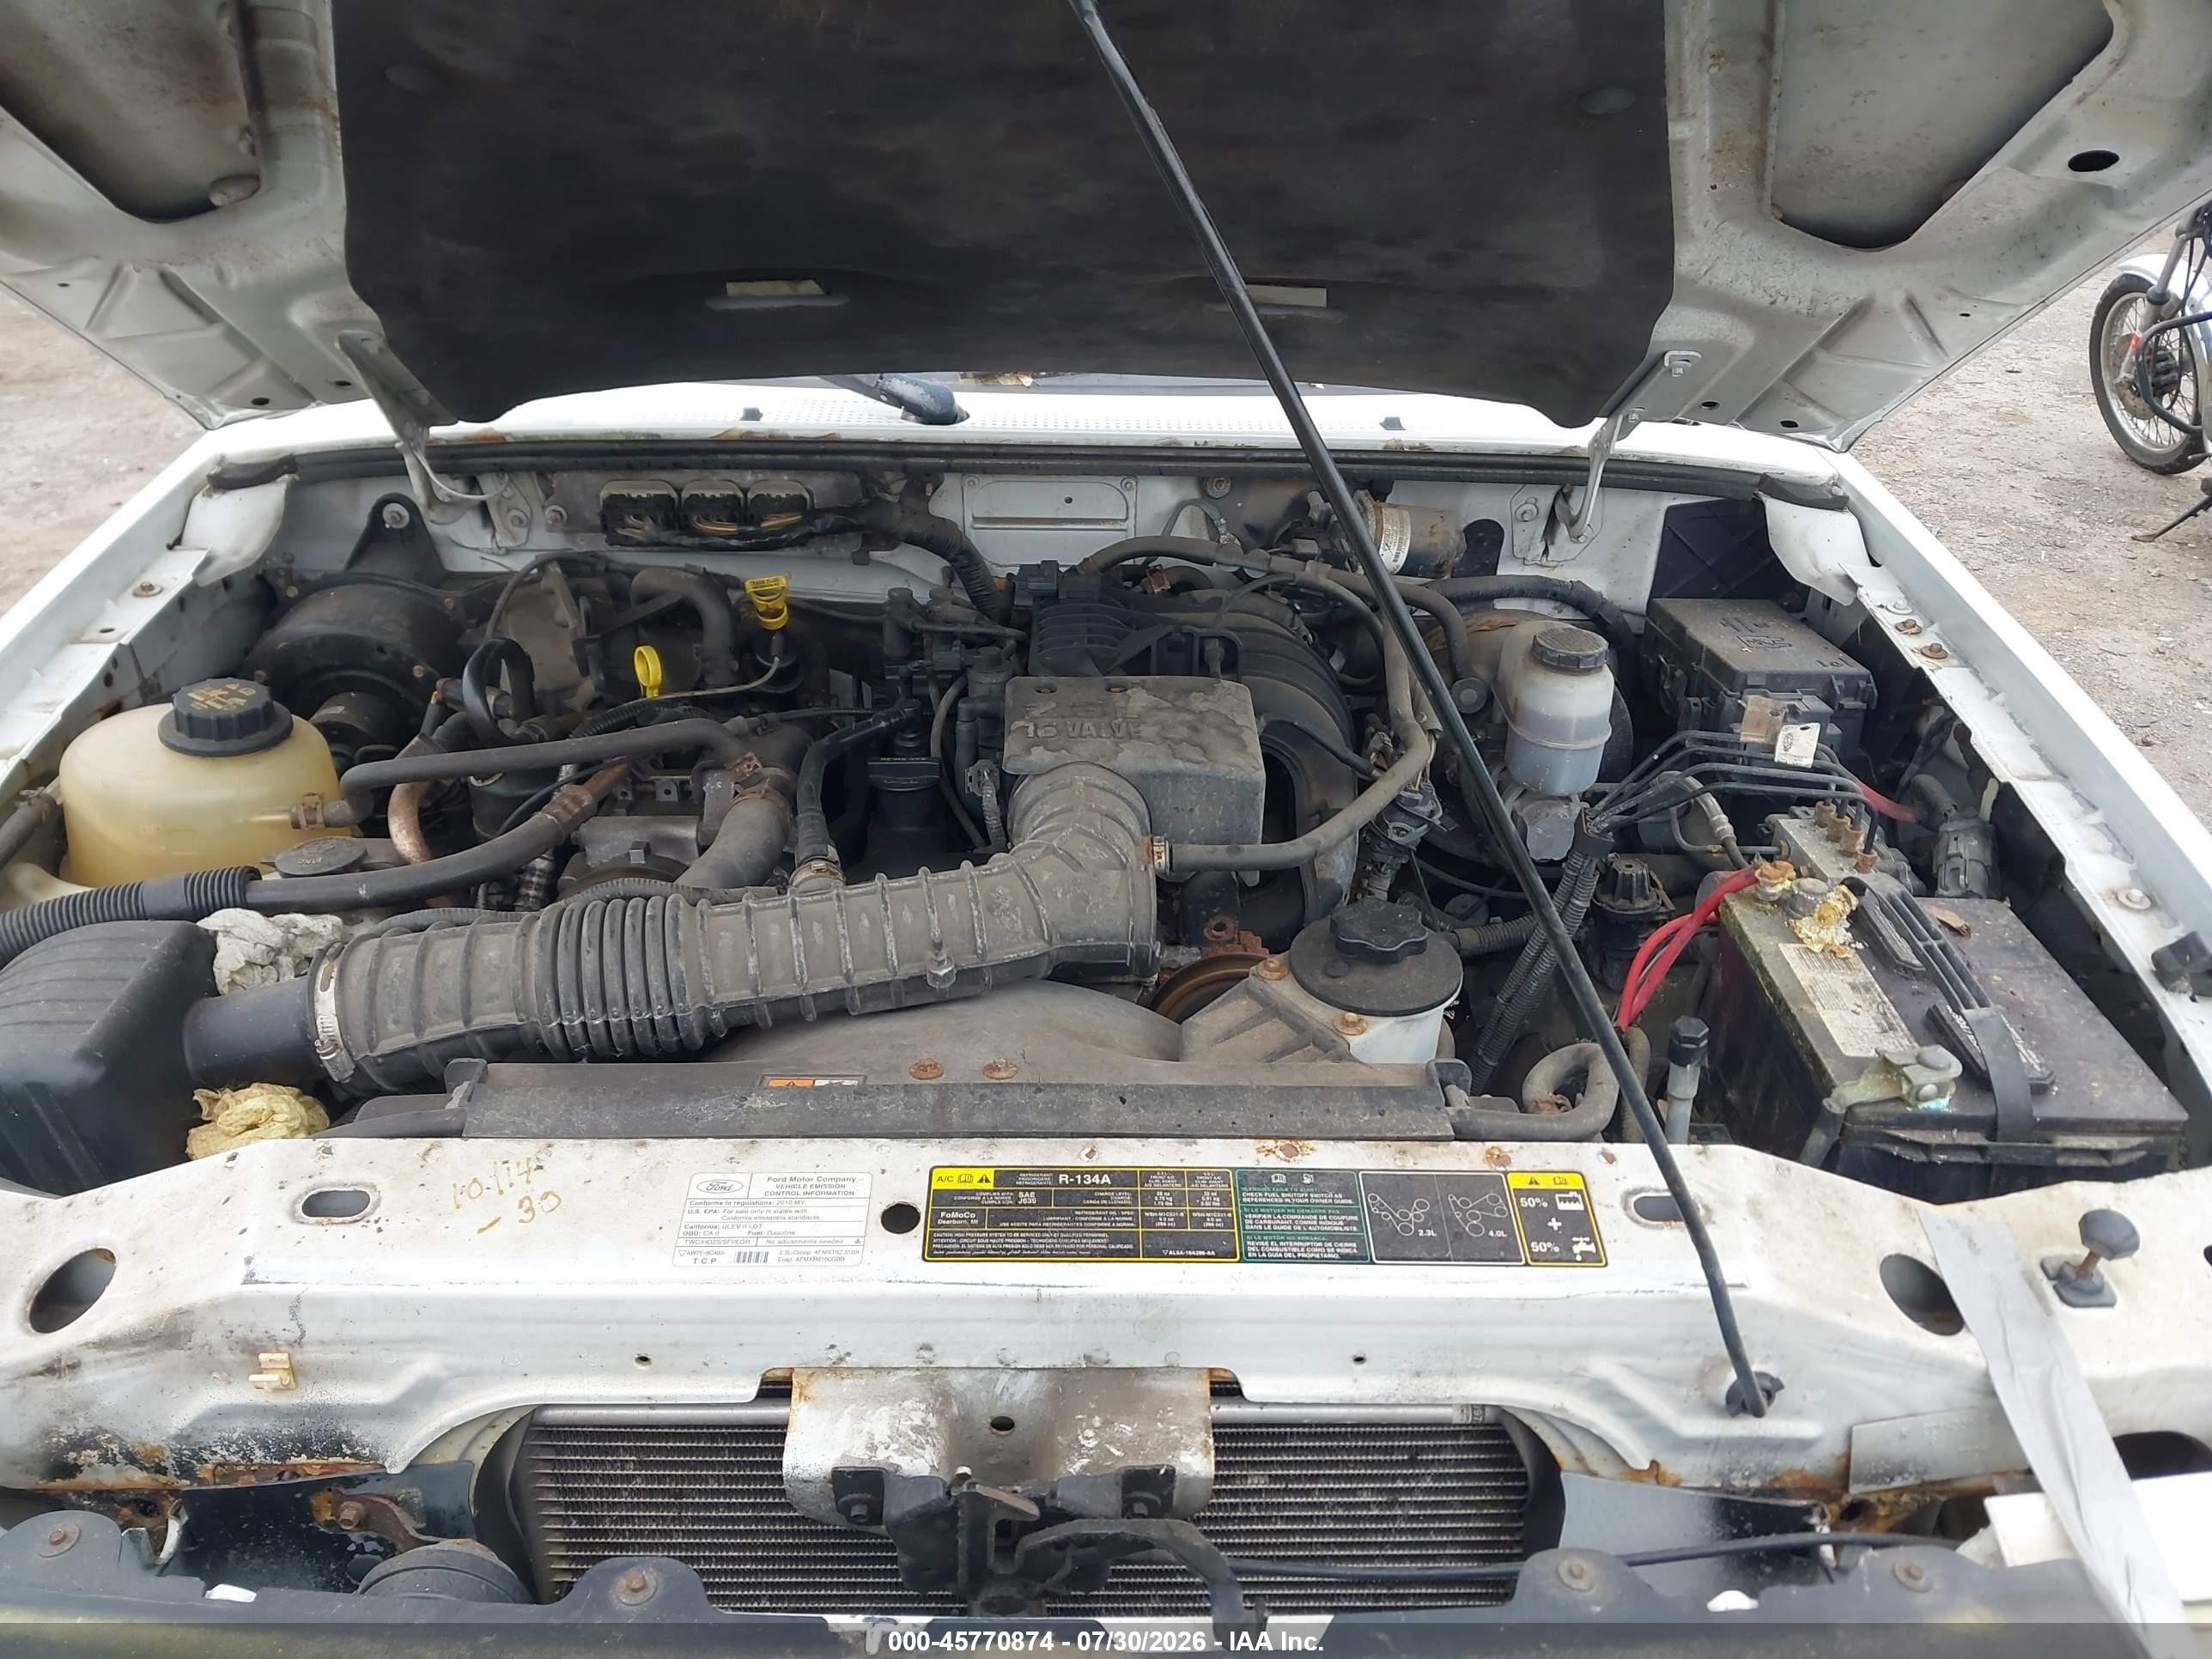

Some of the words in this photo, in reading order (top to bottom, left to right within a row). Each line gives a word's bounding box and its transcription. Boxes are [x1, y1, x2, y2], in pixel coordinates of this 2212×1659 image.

[1066, 720, 1141, 739] VALVE
[1058, 1174, 1111, 1185] R-134A
[706, 1182, 734, 1192] Ford
[1520, 1197, 1548, 1208] 50%
[1530, 1241, 1560, 1253] 50%
